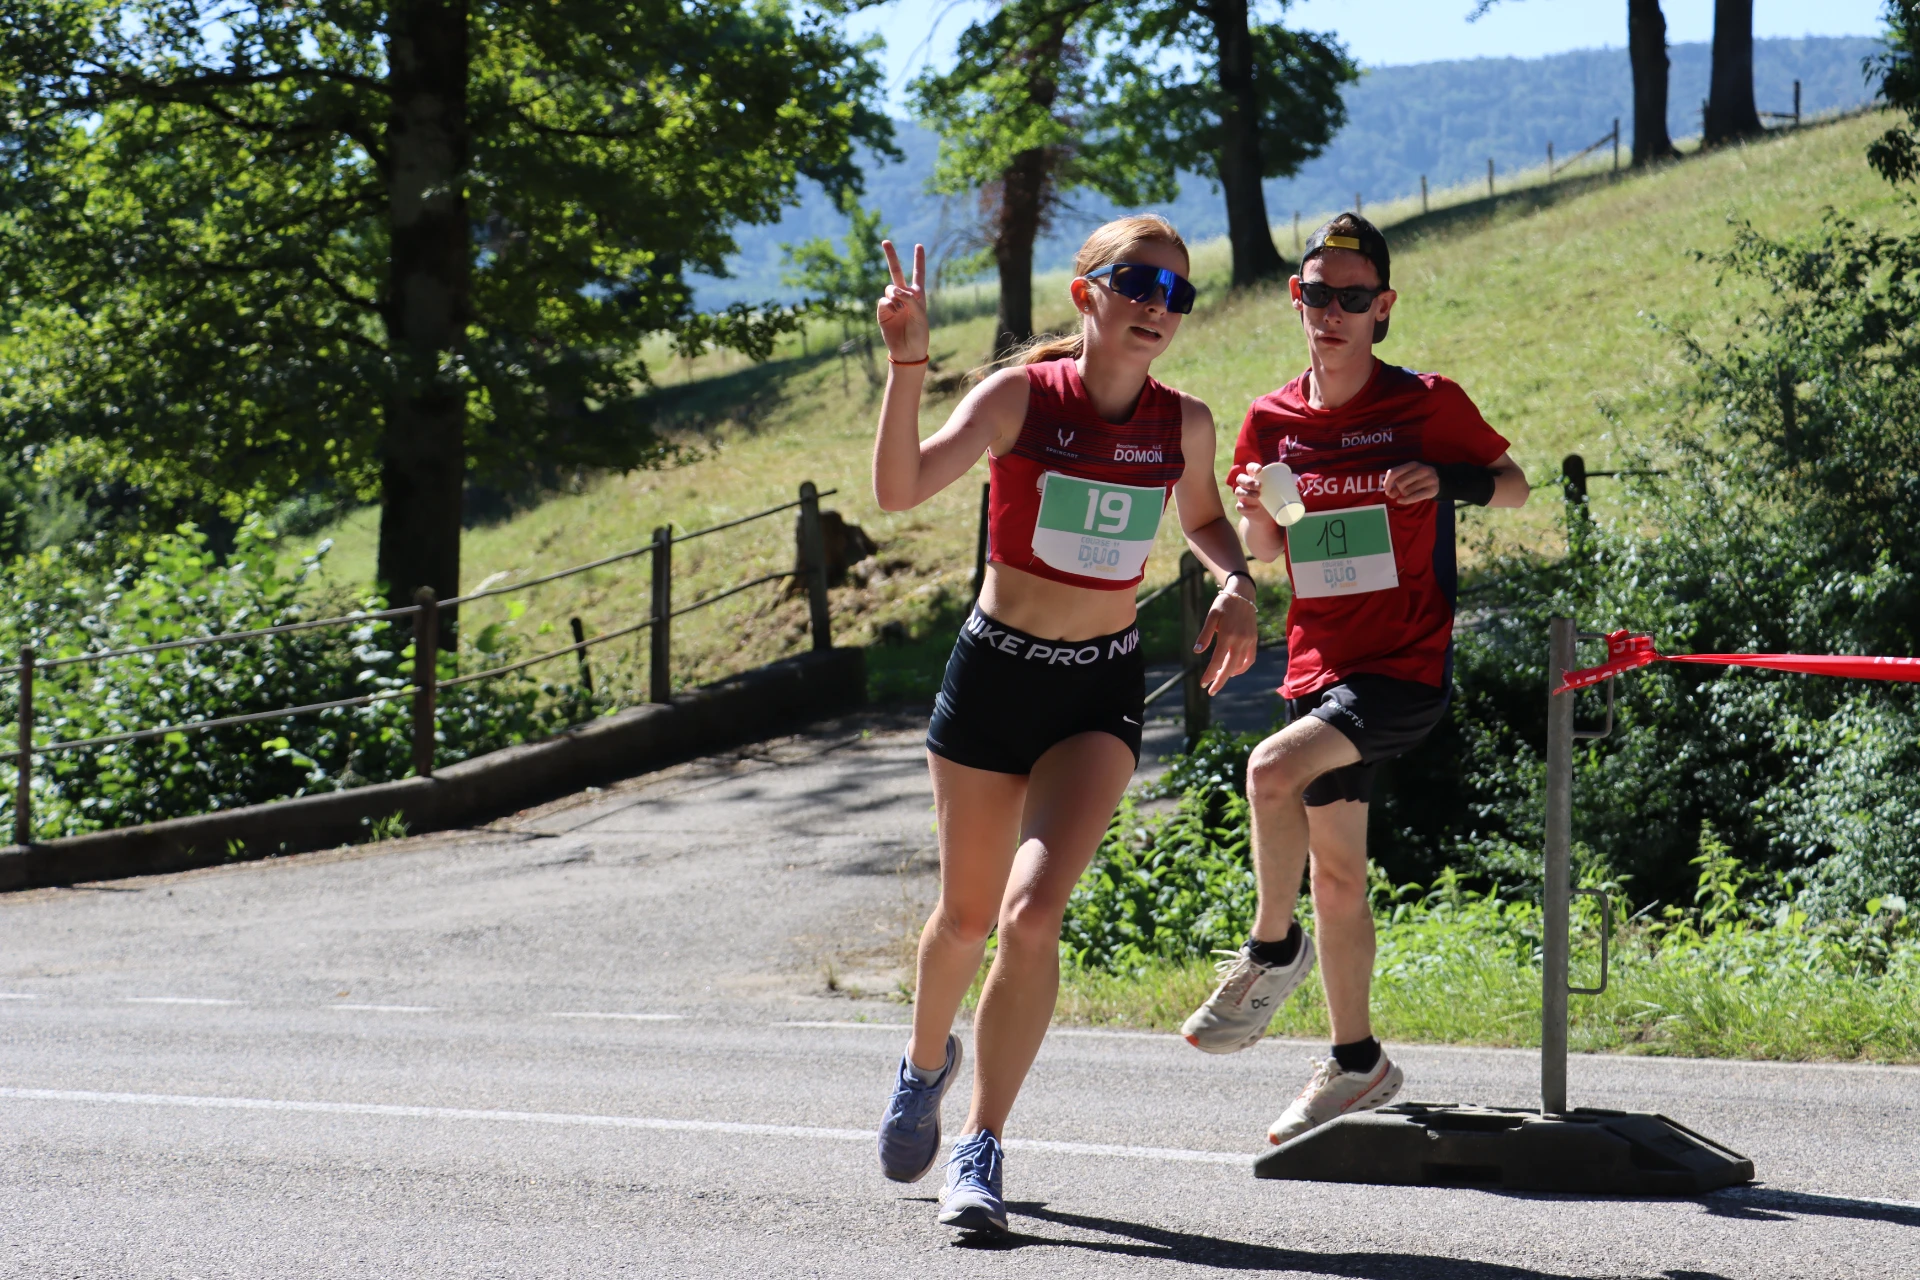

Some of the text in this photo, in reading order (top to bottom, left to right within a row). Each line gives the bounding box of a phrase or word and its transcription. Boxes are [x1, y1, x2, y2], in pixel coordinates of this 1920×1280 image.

[1341, 432, 1393, 448] DOMON
[1113, 449, 1163, 463] DOMON
[1084, 488, 1132, 534] 19
[1317, 519, 1348, 557] 19
[1078, 544, 1120, 567] DUO
[1323, 566, 1357, 584] DUO
[967, 608, 1026, 656] NIKE
[1024, 643, 1100, 666] PRO
[1328, 701, 1359, 721] CRAFT
